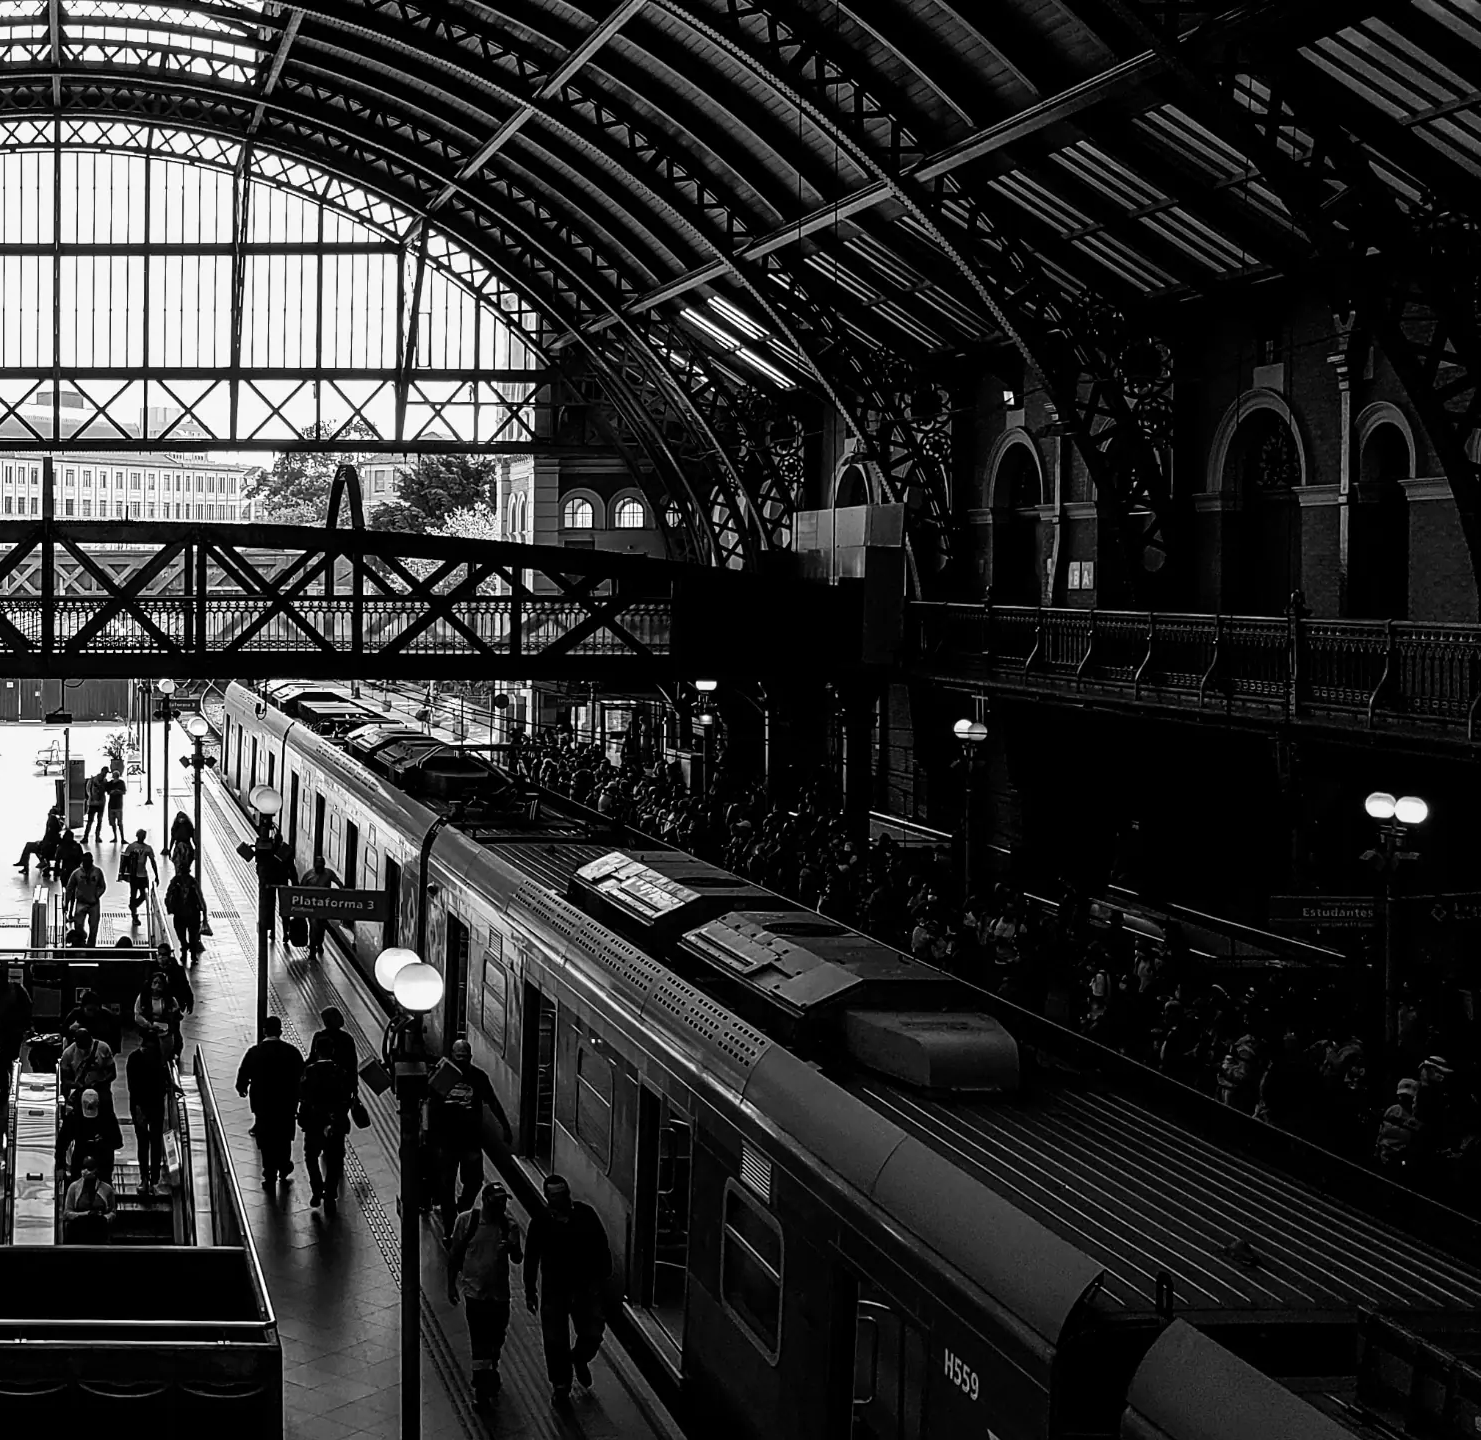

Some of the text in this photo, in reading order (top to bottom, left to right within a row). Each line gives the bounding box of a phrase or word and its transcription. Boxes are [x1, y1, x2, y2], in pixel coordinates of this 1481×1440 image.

[291, 895, 364, 910] Plataforma
[366, 900, 375, 910] 3
[1302, 907, 1375, 918] Estudantes
[944, 1347, 980, 1401] H559
